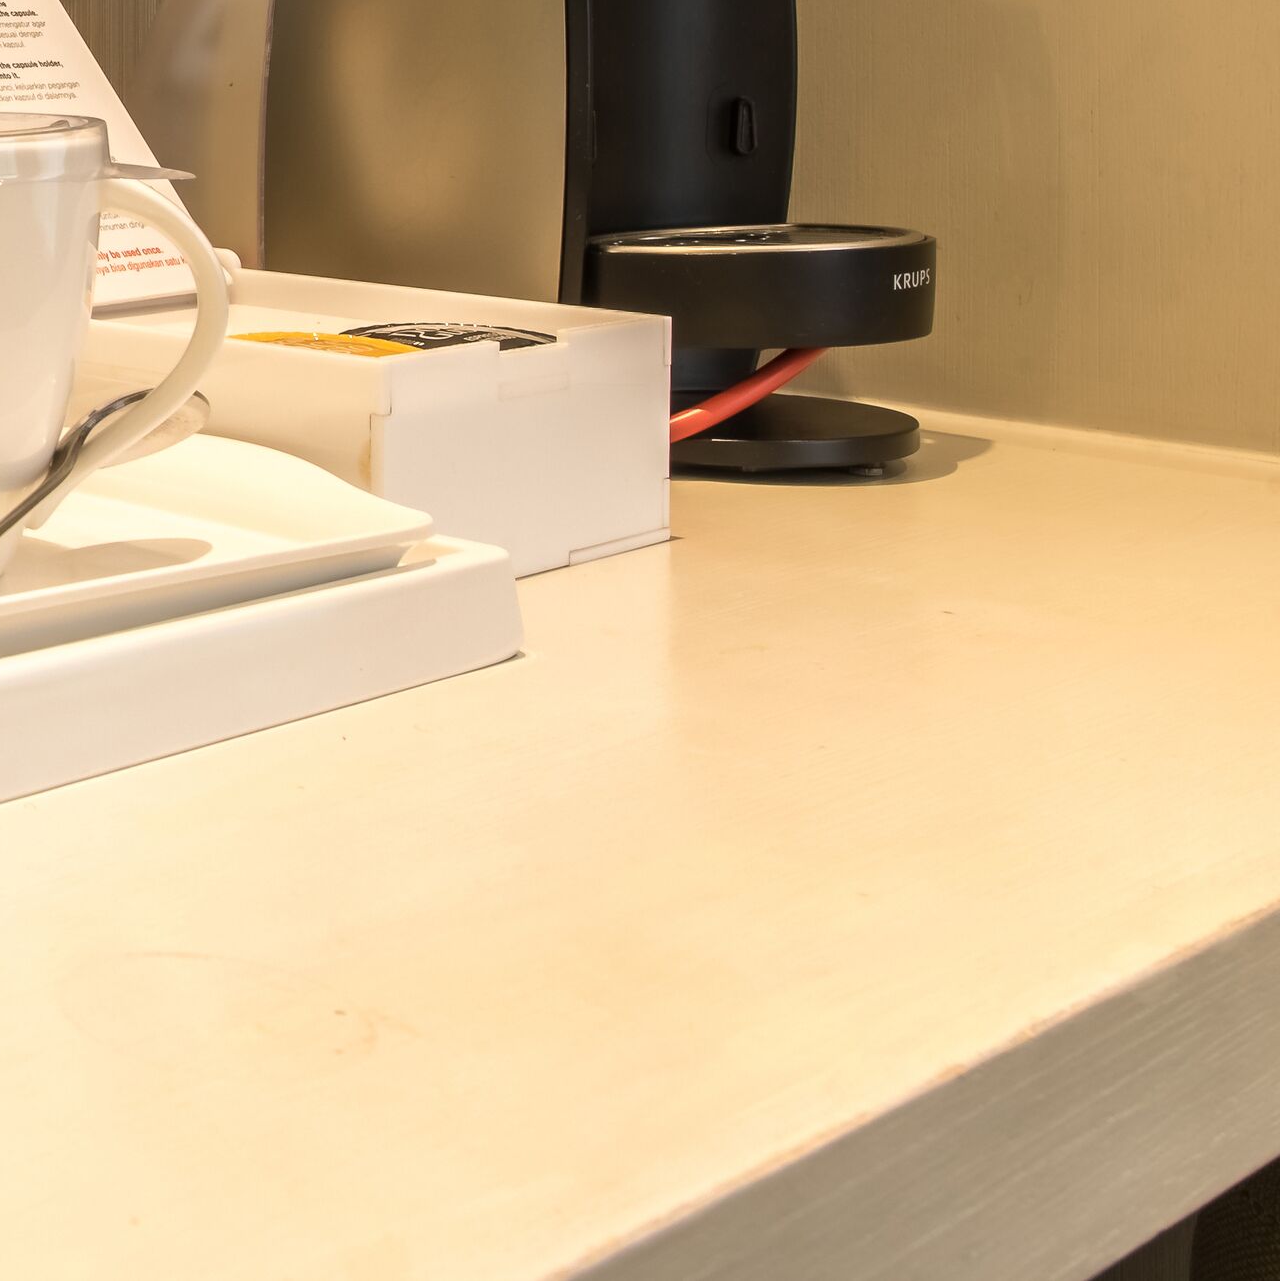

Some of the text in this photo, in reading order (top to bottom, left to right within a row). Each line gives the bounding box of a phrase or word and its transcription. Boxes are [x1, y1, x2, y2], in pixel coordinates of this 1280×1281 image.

[0, 62, 12, 70] the
[12, 60, 38, 70] capsule
[38, 59, 64, 68] holder,
[109, 249, 121, 258] be
[121, 247, 141, 257] used
[893, 267, 931, 291] KRUPS
